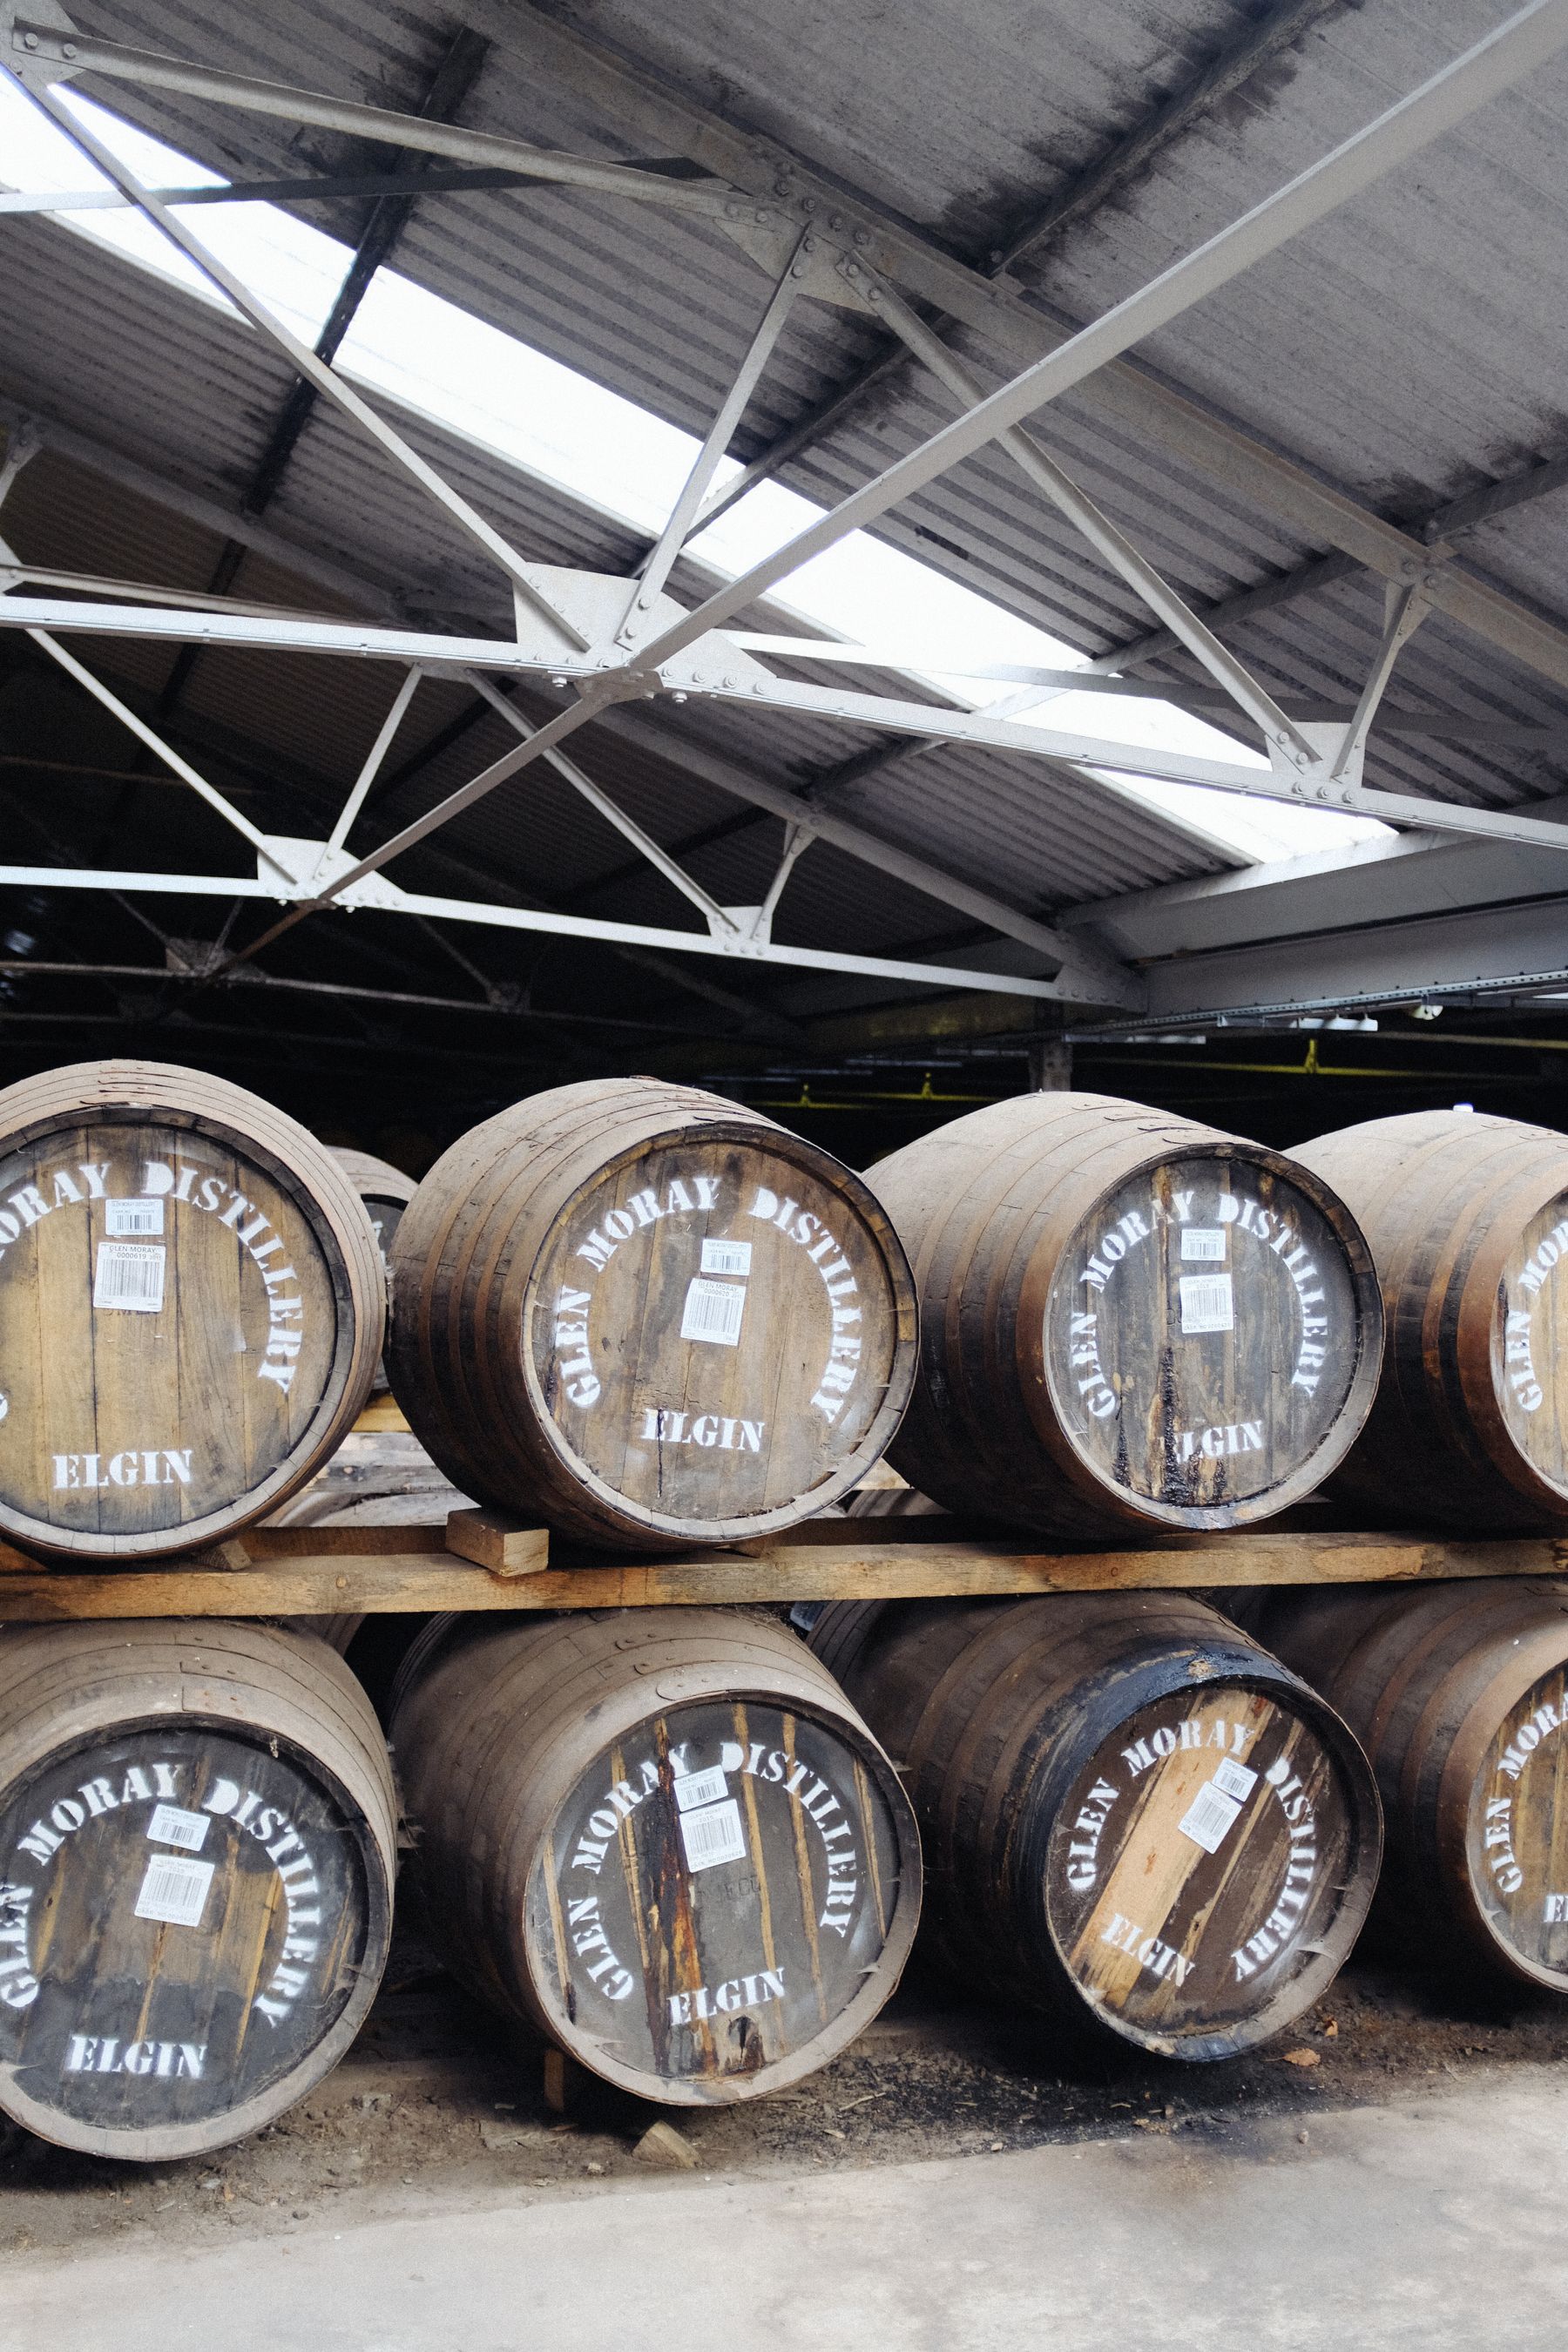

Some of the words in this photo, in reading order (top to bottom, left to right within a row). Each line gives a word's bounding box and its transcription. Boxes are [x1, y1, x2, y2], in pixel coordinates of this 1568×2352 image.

[577, 1177, 722, 1272] MORAY
[1079, 1191, 1194, 1293] MORAY
[0, 1162, 112, 1260] ORAY
[141, 1162, 304, 1394] DISTILLERY
[749, 1187, 862, 1423] DISTILLERY
[1217, 1193, 1328, 1398] DISTILLERY
[556, 1286, 602, 1409] GLEN
[1070, 1312, 1116, 1417] GLEN
[1508, 1309, 1543, 1411] GLEN
[52, 1449, 194, 1490] ELGIN
[641, 1409, 765, 1452] ELGIN
[17, 1762, 184, 1867] MORAY
[571, 1743, 689, 1874] MORAY
[720, 1741, 857, 1938] DISTILLERY
[1066, 1777, 1120, 1891] GLEN
[1120, 1720, 1254, 1777] MORAY
[1231, 1756, 1316, 1982] DISTILLERY
[1486, 1797, 1523, 1893] GLEN
[0, 1882, 39, 2008] GLEN
[202, 1777, 322, 2028] DISTILLERY
[567, 1896, 634, 2001] GLEN
[1100, 1913, 1196, 1986] ELGIN
[668, 1968, 785, 2026] ELGIN
[66, 2035, 207, 2079] ELGIN
